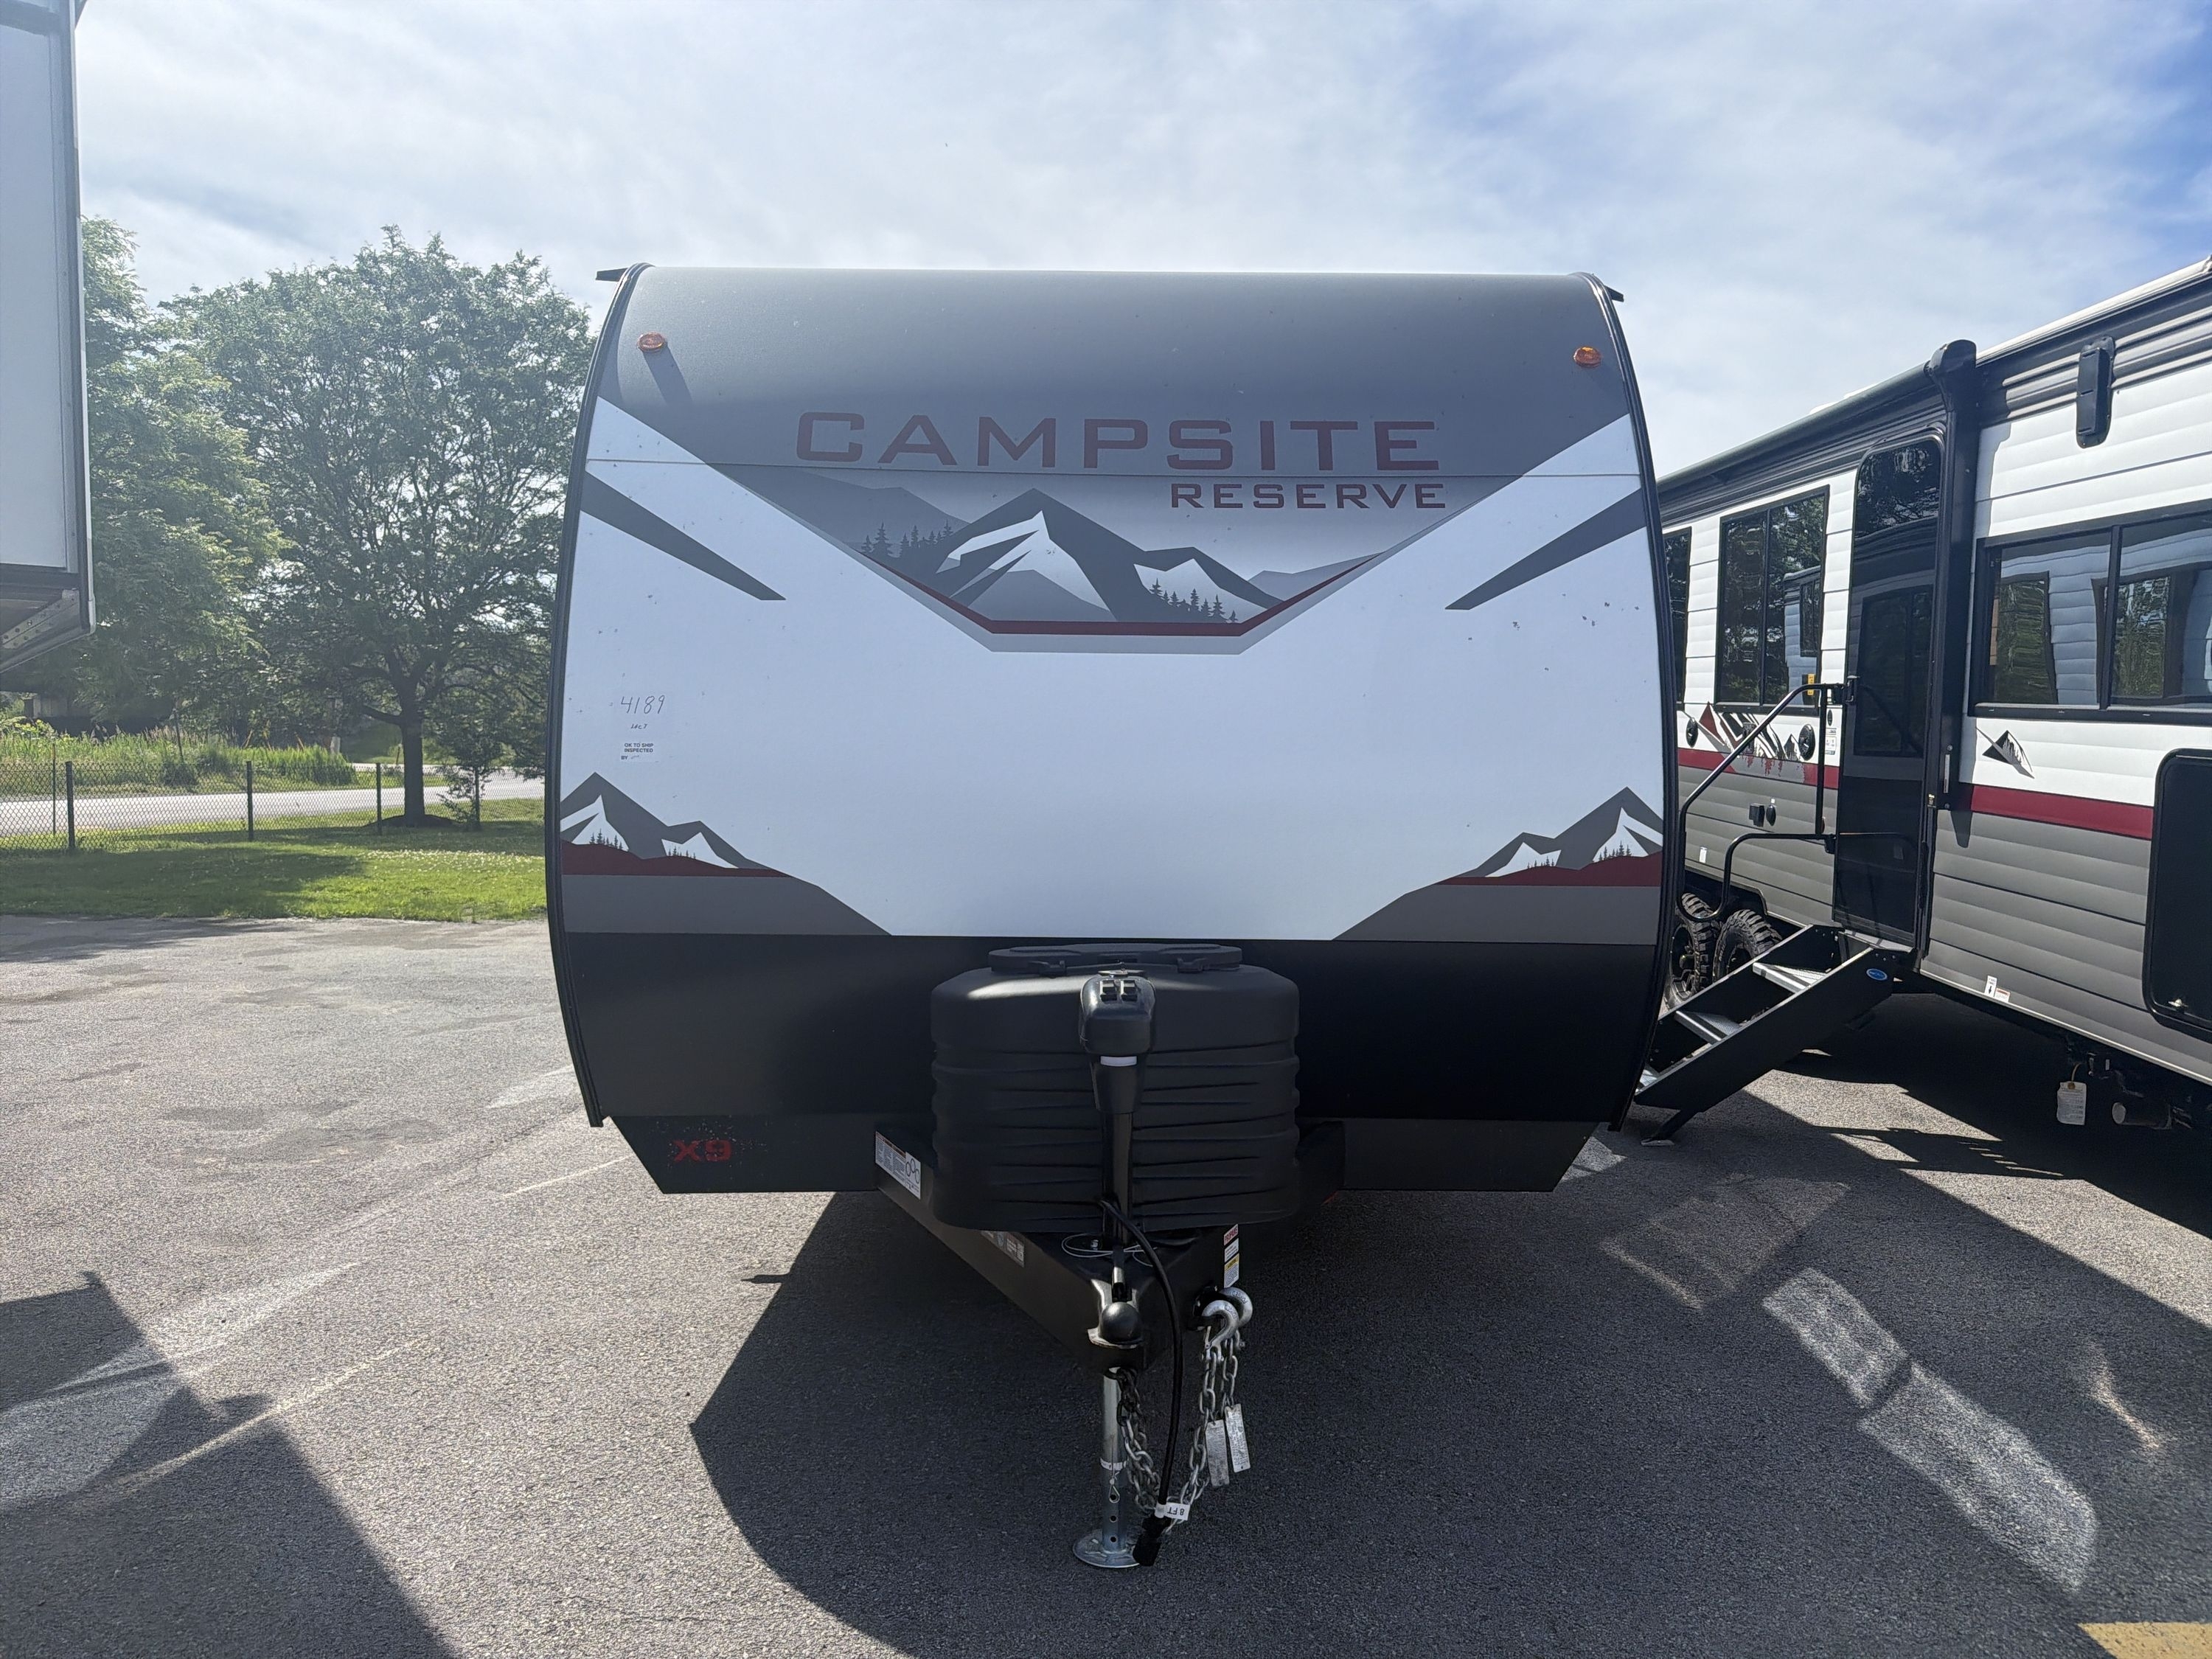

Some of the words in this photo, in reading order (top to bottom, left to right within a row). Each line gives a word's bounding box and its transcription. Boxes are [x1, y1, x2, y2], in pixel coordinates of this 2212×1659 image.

[796, 411, 1439, 471] CAMPSITE
[1172, 483, 1446, 509] RESERVE
[621, 695, 666, 714] 4189
[1166, 1506, 1178, 1515] FT
[1180, 1508, 1185, 1516] 8
